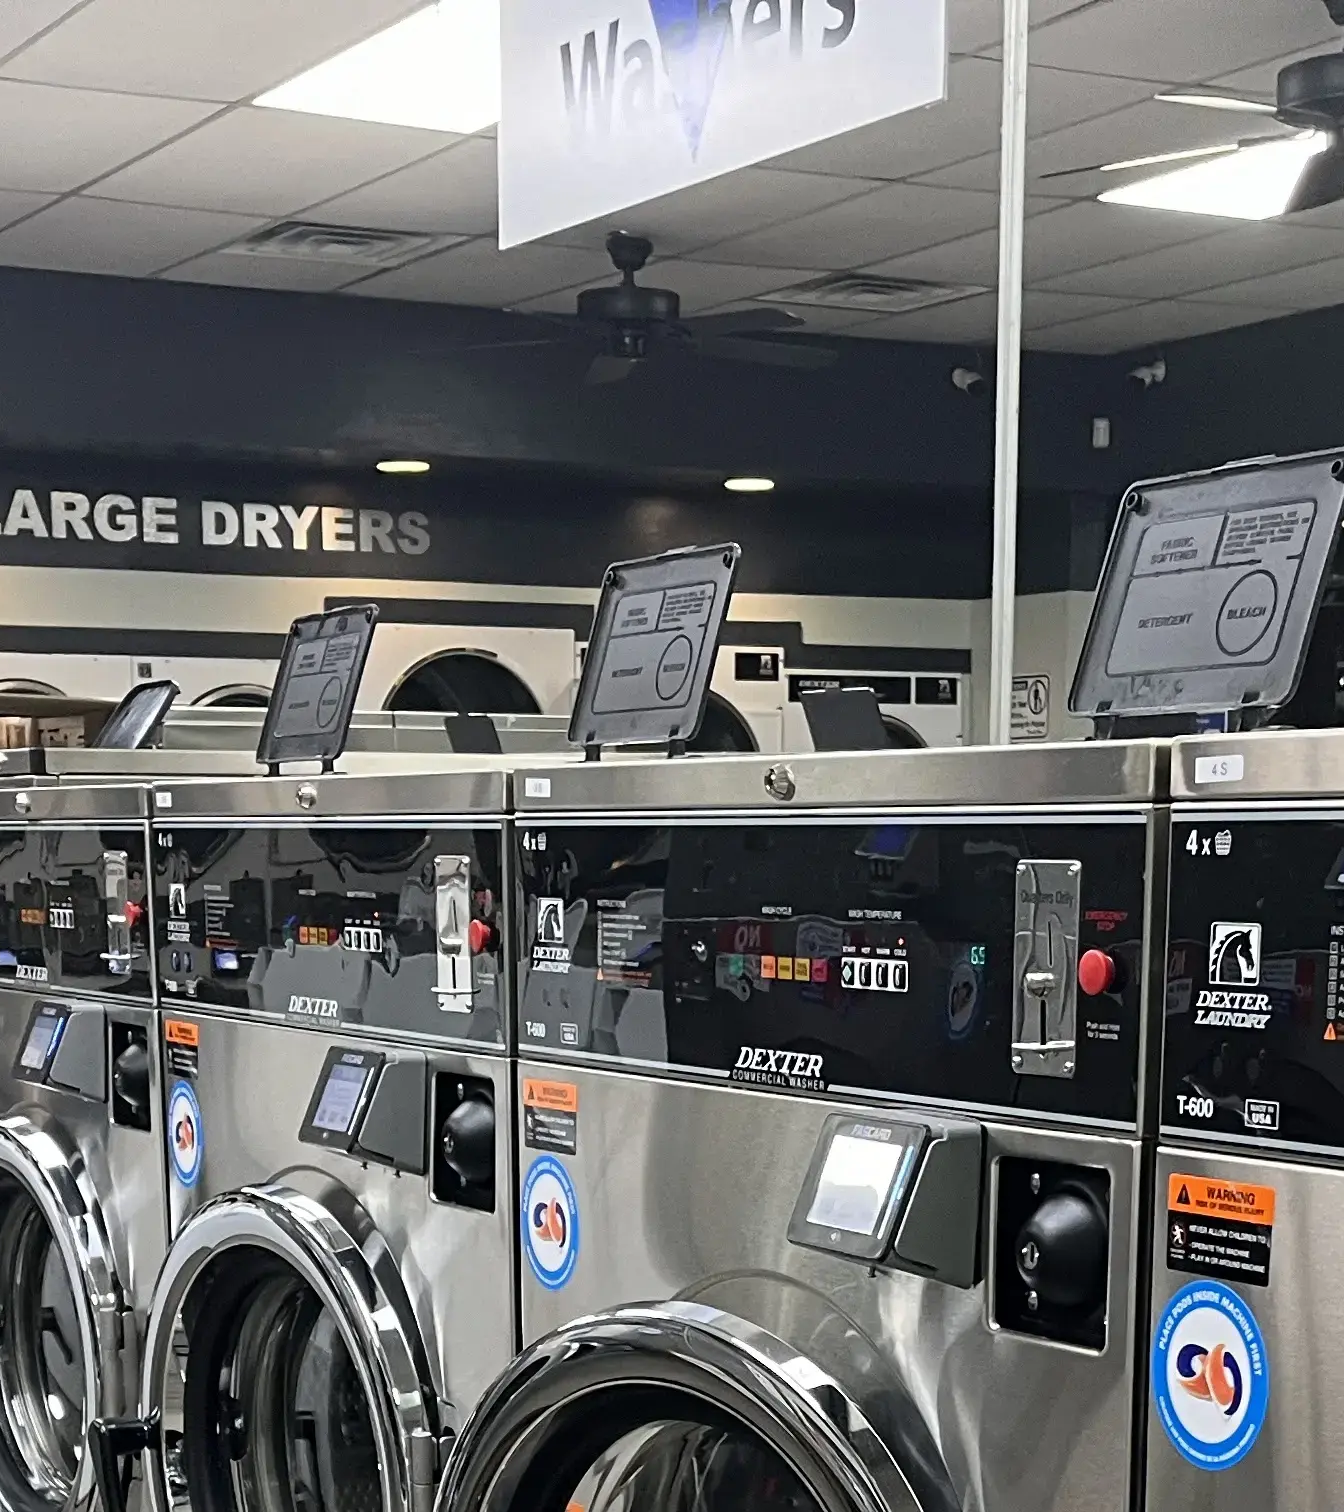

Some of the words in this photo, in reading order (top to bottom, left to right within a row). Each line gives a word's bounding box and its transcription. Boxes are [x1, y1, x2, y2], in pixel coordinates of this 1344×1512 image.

[201, 499, 431, 556] DRYERS
[1137, 613, 1194, 629] DETERGENT
[1226, 606, 1268, 620] BLEACH
[532, 947, 570, 960] DEXTER
[288, 995, 338, 1018] DEXTER
[1196, 991, 1269, 1010] DEXTER
[1194, 1010, 1271, 1029] LAUNDRY
[735, 1046, 824, 1077] DEXTER
[732, 1068, 787, 1087] COMMERCIAL
[788, 1075, 825, 1091] WASHER
[1176, 1095, 1213, 1118] T-600
[1251, 1112, 1272, 1125] USA
[1207, 1186, 1256, 1206] WARNING
[1159, 1314, 1174, 1350] PLACE
[1172, 1294, 1193, 1318] PODS
[1192, 1290, 1220, 1304] INSIDE
[1220, 1296, 1254, 1341] MACHINE
[1249, 1342, 1264, 1377] FIRST
